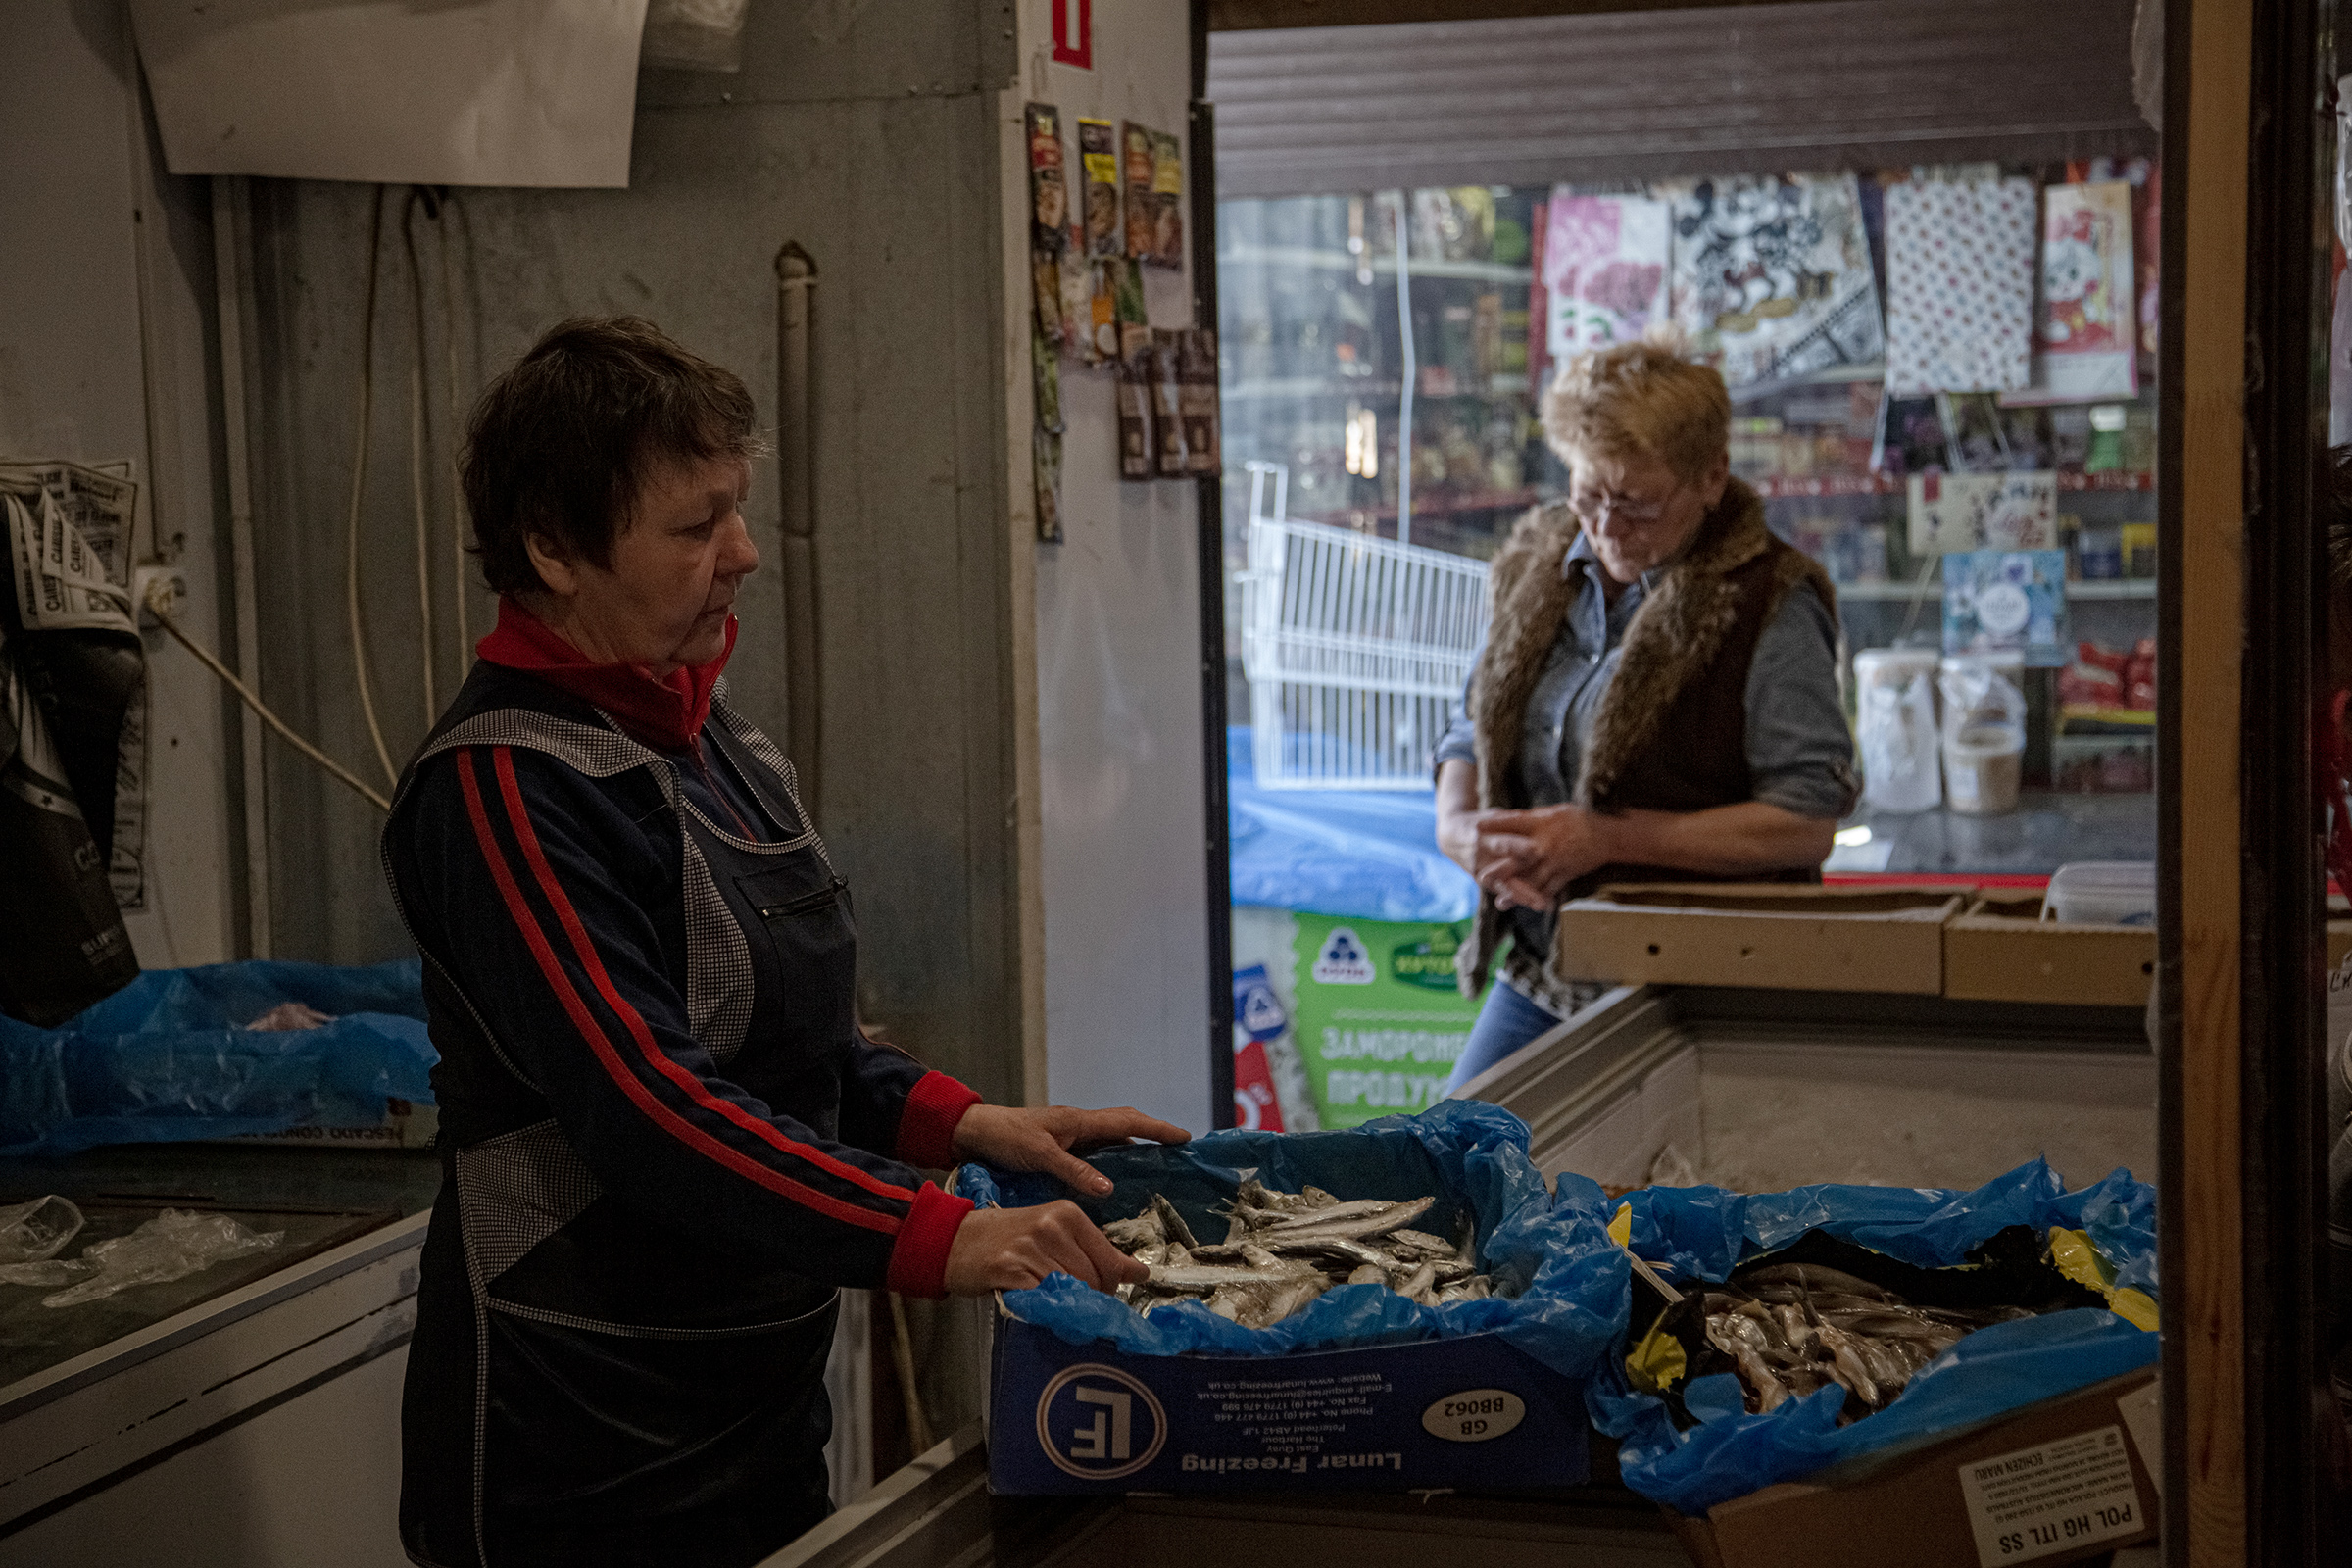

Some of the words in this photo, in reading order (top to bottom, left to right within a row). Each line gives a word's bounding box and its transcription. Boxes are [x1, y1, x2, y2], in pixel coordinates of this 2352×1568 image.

[1208, 1377, 1334, 1391] www.lunarfreezing.co.uk
[1338, 1373, 1381, 1384] Website:
[1197, 1385, 1353, 1401] enquiries@lunarfreezing.co.uk
[1356, 1383, 1392, 1394] E-mail:
[1291, 1400, 1303, 1409] (0)
[1307, 1399, 1325, 1408] +44
[1348, 1396, 1366, 1405] Fax
[1445, 1397, 1503, 1418] BB062
[1284, 1411, 1297, 1420] (0)
[1294, 1423, 1345, 1433] Peterhead
[1460, 1420, 1488, 1435] GB
[1266, 1445, 1293, 1454] Quay
[1182, 1453, 1307, 1474] Freezing
[1317, 1453, 1402, 1471] Lunar
[2005, 1452, 2043, 1473] ECHIZEN
[1974, 1463, 2004, 1482] MARU
[2110, 1471, 2131, 1482] LATIN
[2084, 1476, 2109, 1489] NAME:
[2096, 1503, 2132, 1529] POL
[2063, 1514, 2091, 1538] HG
[2029, 1523, 2058, 1546] ITL
[1998, 1532, 2025, 1554] SS
